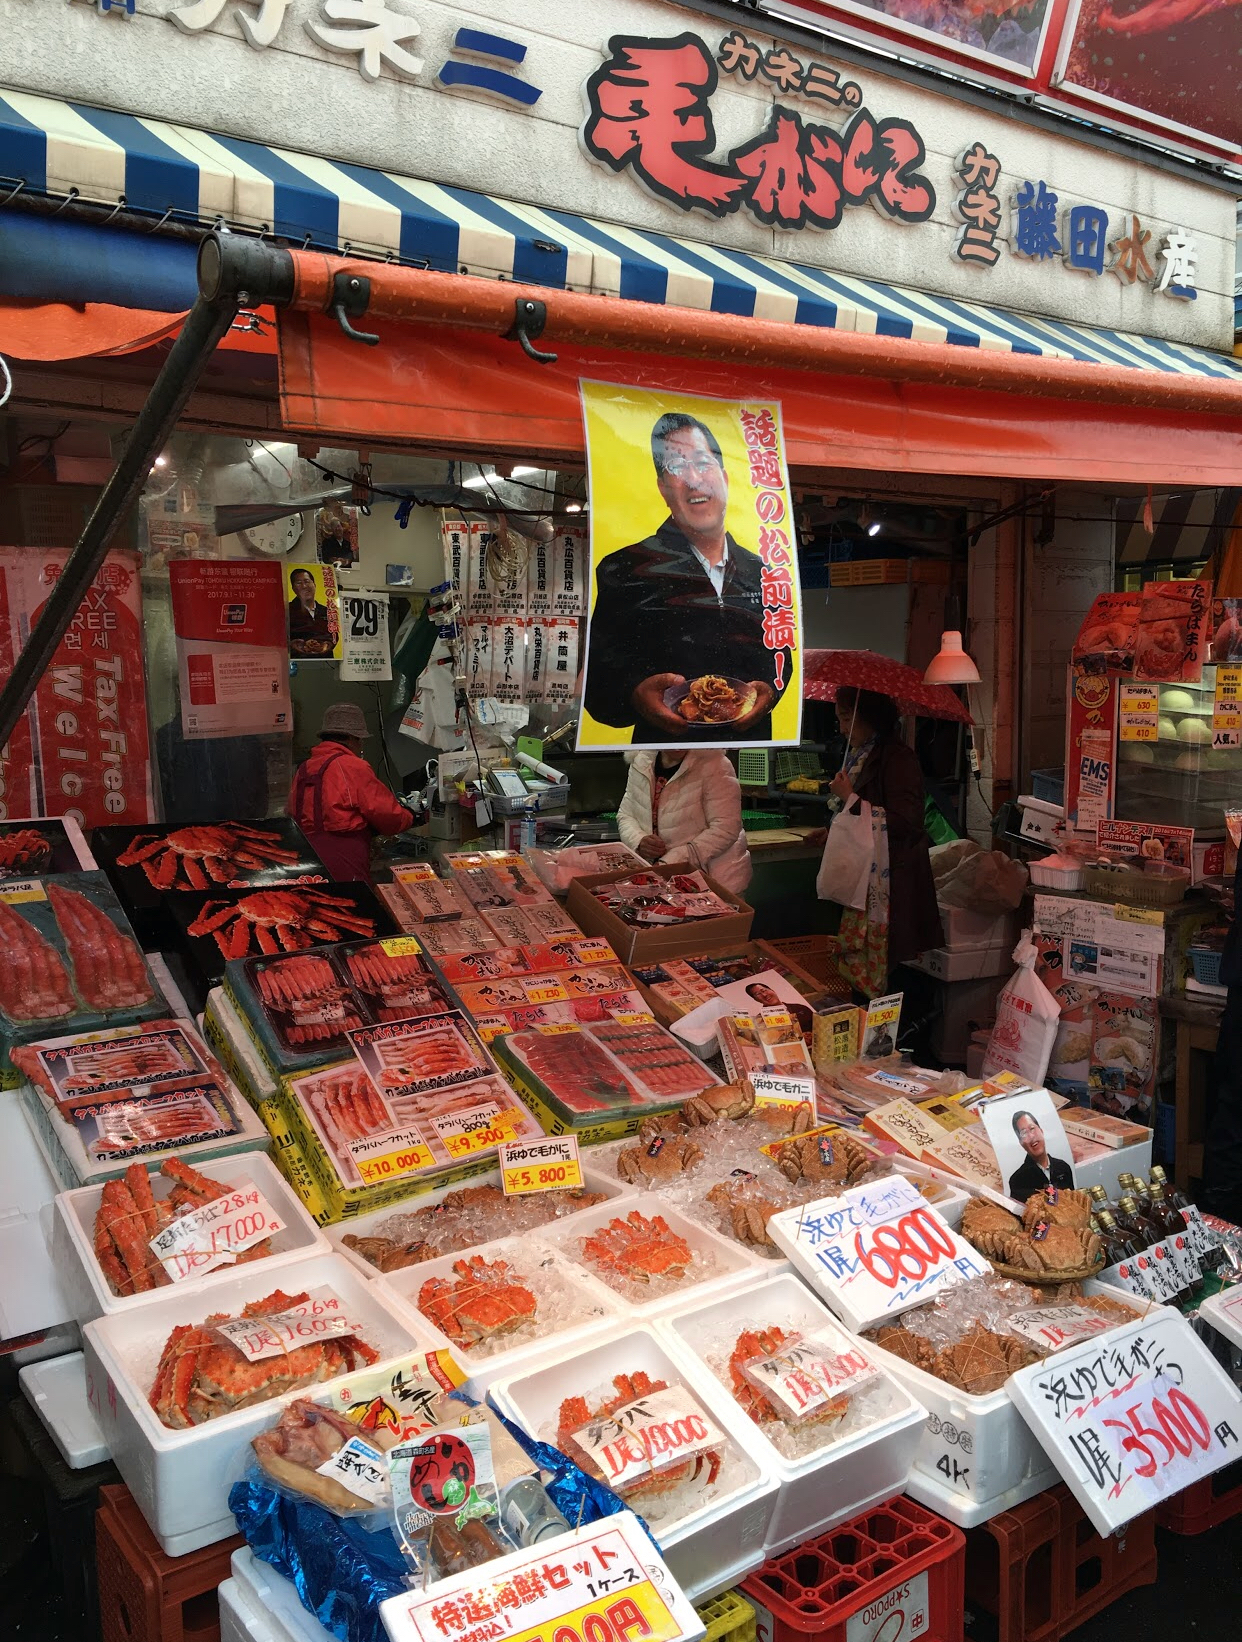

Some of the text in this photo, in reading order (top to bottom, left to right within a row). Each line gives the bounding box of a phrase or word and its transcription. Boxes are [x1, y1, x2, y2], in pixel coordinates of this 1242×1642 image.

[714, 31, 863, 108] カネニの
[583, 32, 936, 232] 毛がに
[955, 141, 1002, 267] カネニ
[1014, 180, 1198, 300] 藤田水産
[564, 536, 574, 592] 丸広百貨店
[349, 598, 379, 637] 29
[1183, 583, 1205, 662] たらばまん
[557, 630, 569, 672] 井筒屋
[95, 655, 129, 814] Tax Free
[1081, 756, 1110, 781] EMS
[513, 1007, 547, 1022] たらば
[600, 994, 631, 1009] たらば
[354, 1016, 455, 1046] タラバガニハーフカット
[45, 1034, 172, 1061] タラバガニハーフカット
[753, 1078, 811, 1095] 浜ゆで毛ガニ
[437, 1109, 499, 1130] タラバハーフカット
[351, 1131, 417, 1154] タラバハーフカット
[506, 1143, 570, 1162] 浜ゆで毛がに
[586, 1568, 641, 1598] 1ケース
